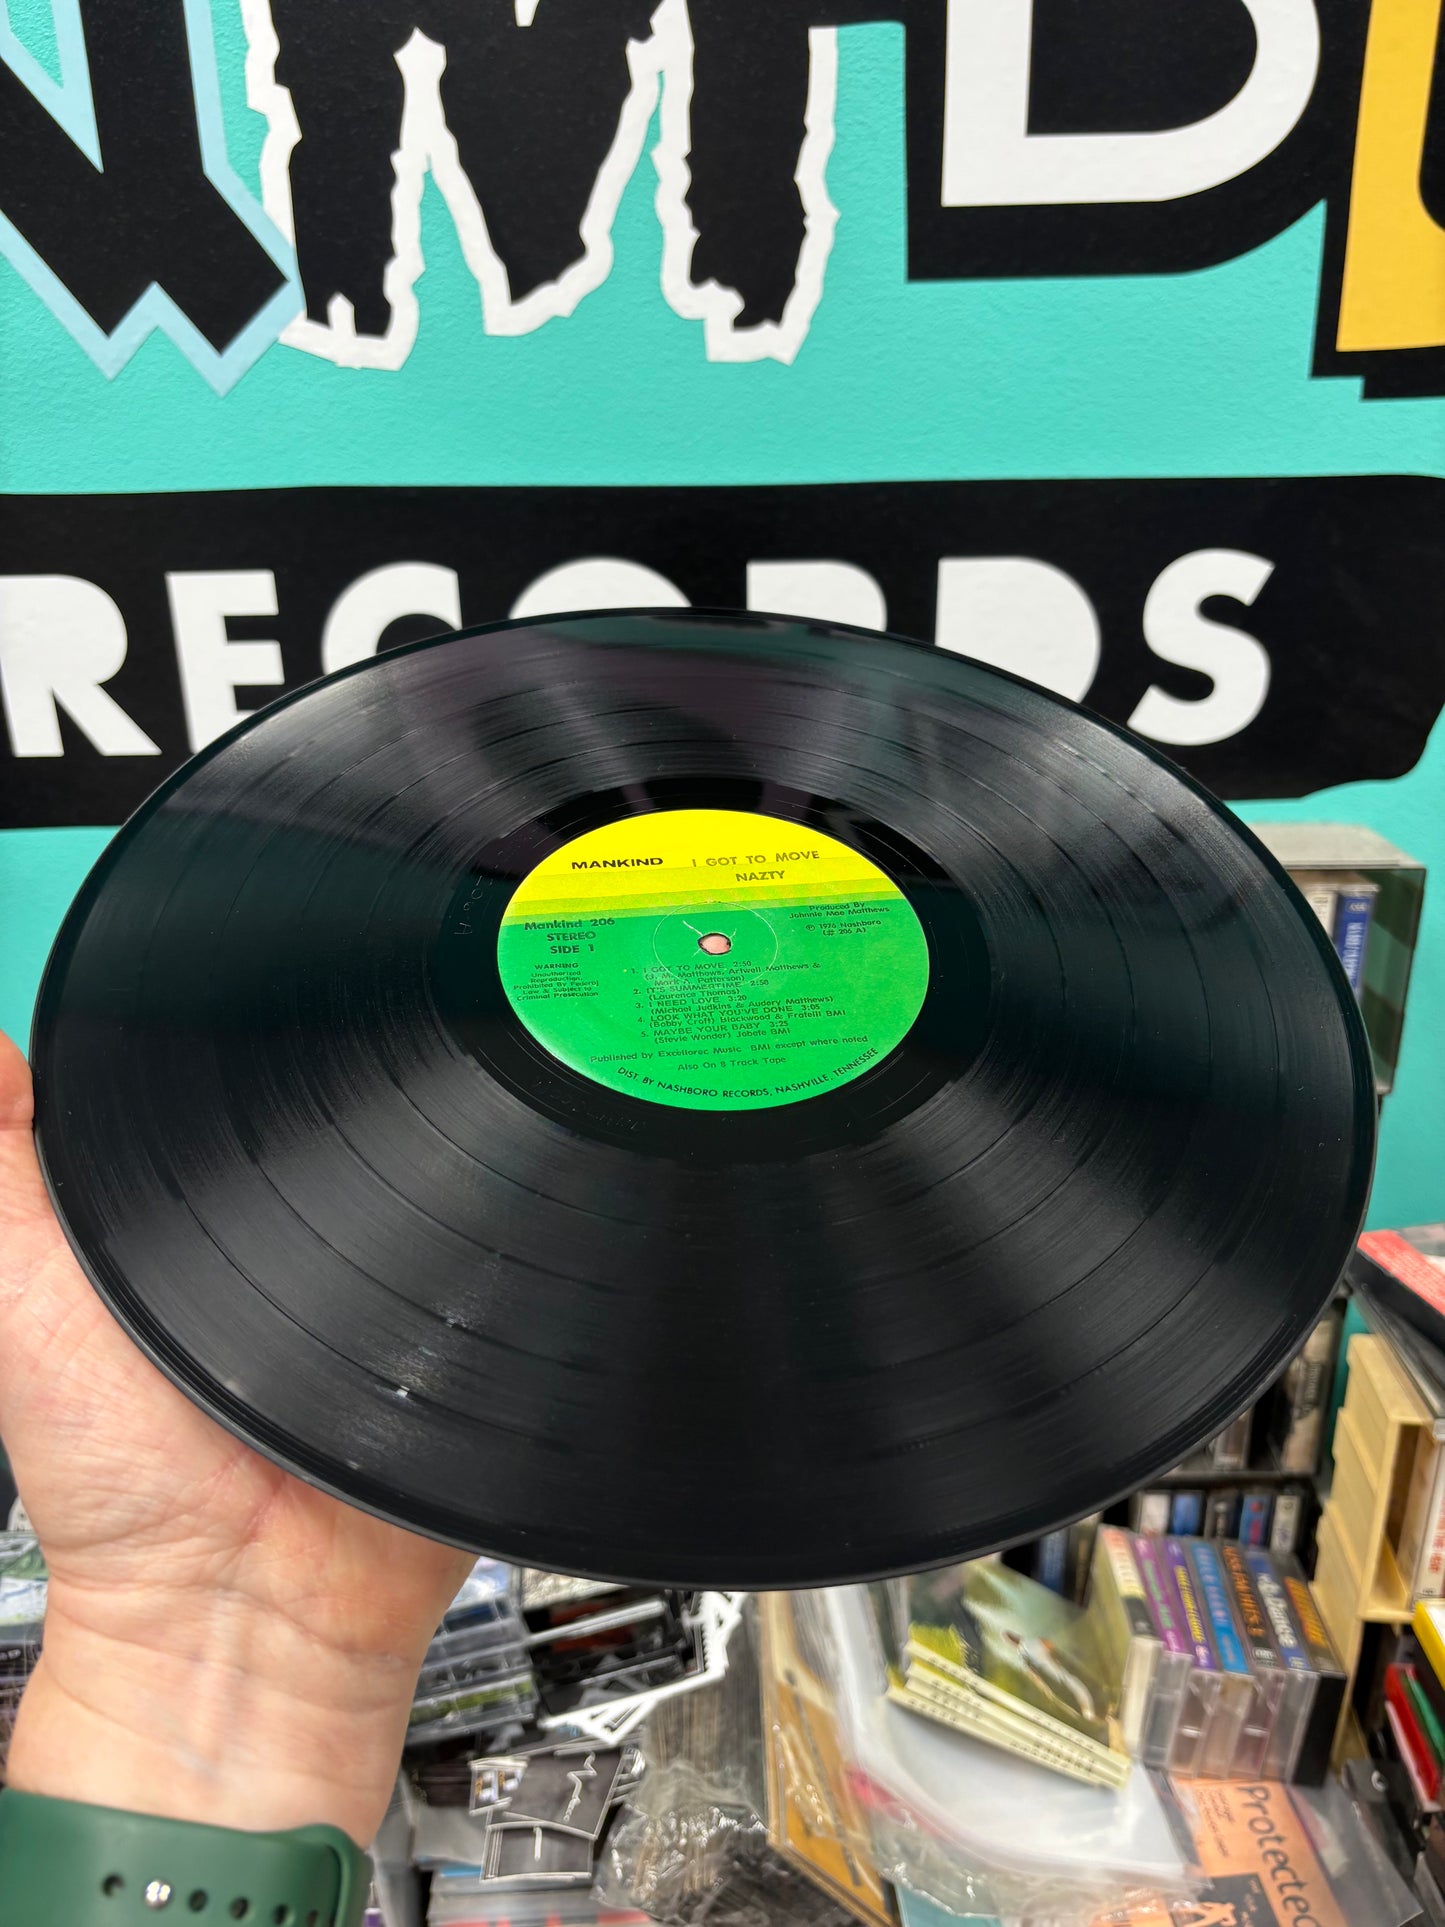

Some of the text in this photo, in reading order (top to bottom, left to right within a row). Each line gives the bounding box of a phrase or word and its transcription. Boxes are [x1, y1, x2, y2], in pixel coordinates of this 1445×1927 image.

[0, 549, 1275, 757] RECDS
[571, 857, 664, 870] MANKIND
[692, 850, 820, 868] I GOT TO MOVE
[735, 870, 785, 882] NAZTY
[789, 906, 890, 919] Johnnie Mae Matthews
[808, 903, 850, 912] Produced
[524, 917, 616, 931] Mankind 206
[840, 919, 882, 929] Nashboro
[546, 931, 597, 942] STEREO
[838, 928, 853, 936] 206
[550, 943, 595, 955] SIDE 1
[534, 962, 579, 970] WARNING
[651, 966, 671, 974] GOT
[676, 964, 691, 972] TO
[694, 962, 724, 970] MOVE
[765, 963, 809, 972] Matthews
[531, 970, 581, 978] Unauthorized
[697, 974, 745, 985] Patterson)
[513, 982, 553, 990] Prohibited
[669, 981, 741, 993] SUMMERTIME
[516, 991, 599, 1002] Criminal Prosecution
[649, 988, 740, 1002] (Laurence Thomas)
[657, 999, 687, 1008] NEED
[691, 996, 720, 1005] LOVE
[728, 994, 748, 1002] 3:20
[651, 1005, 692, 1015] (Michael
[696, 1003, 732, 1012] Judkins
[785, 995, 834, 1005] Matthews)
[649, 1020, 683, 1029] (Bobby
[720, 1013, 771, 1023] Blackwood
[826, 1009, 846, 1018] BMI
[650, 1014, 679, 1022] LOOK
[683, 1011, 715, 1020] WHAT
[718, 1007, 759, 1017] YOU'VE
[763, 1005, 794, 1014] DONE
[801, 1003, 820, 1012] 3:05
[653, 1027, 693, 1037] MAYBE
[696, 1024, 728, 1033] YOUR
[731, 1022, 760, 1031] BABY
[769, 1020, 789, 1028] 3:25
[654, 1028, 791, 1044] (Stevie Wonder) Jobete BMI
[590, 1052, 638, 1063] Published
[641, 1051, 653, 1060] by
[713, 1046, 742, 1055] Music
[750, 1043, 771, 1053] BMI
[775, 1040, 806, 1050] except
[809, 1037, 839, 1046] where
[842, 1035, 868, 1044] noted
[677, 1062, 699, 1072] Also
[702, 1061, 717, 1069] On
[730, 1058, 759, 1068] Track
[763, 1056, 786, 1065] Tape
[617, 1047, 879, 1098] DIST. BY NASHBORO RECORDS, NASHVILLE, TENNESSEE
